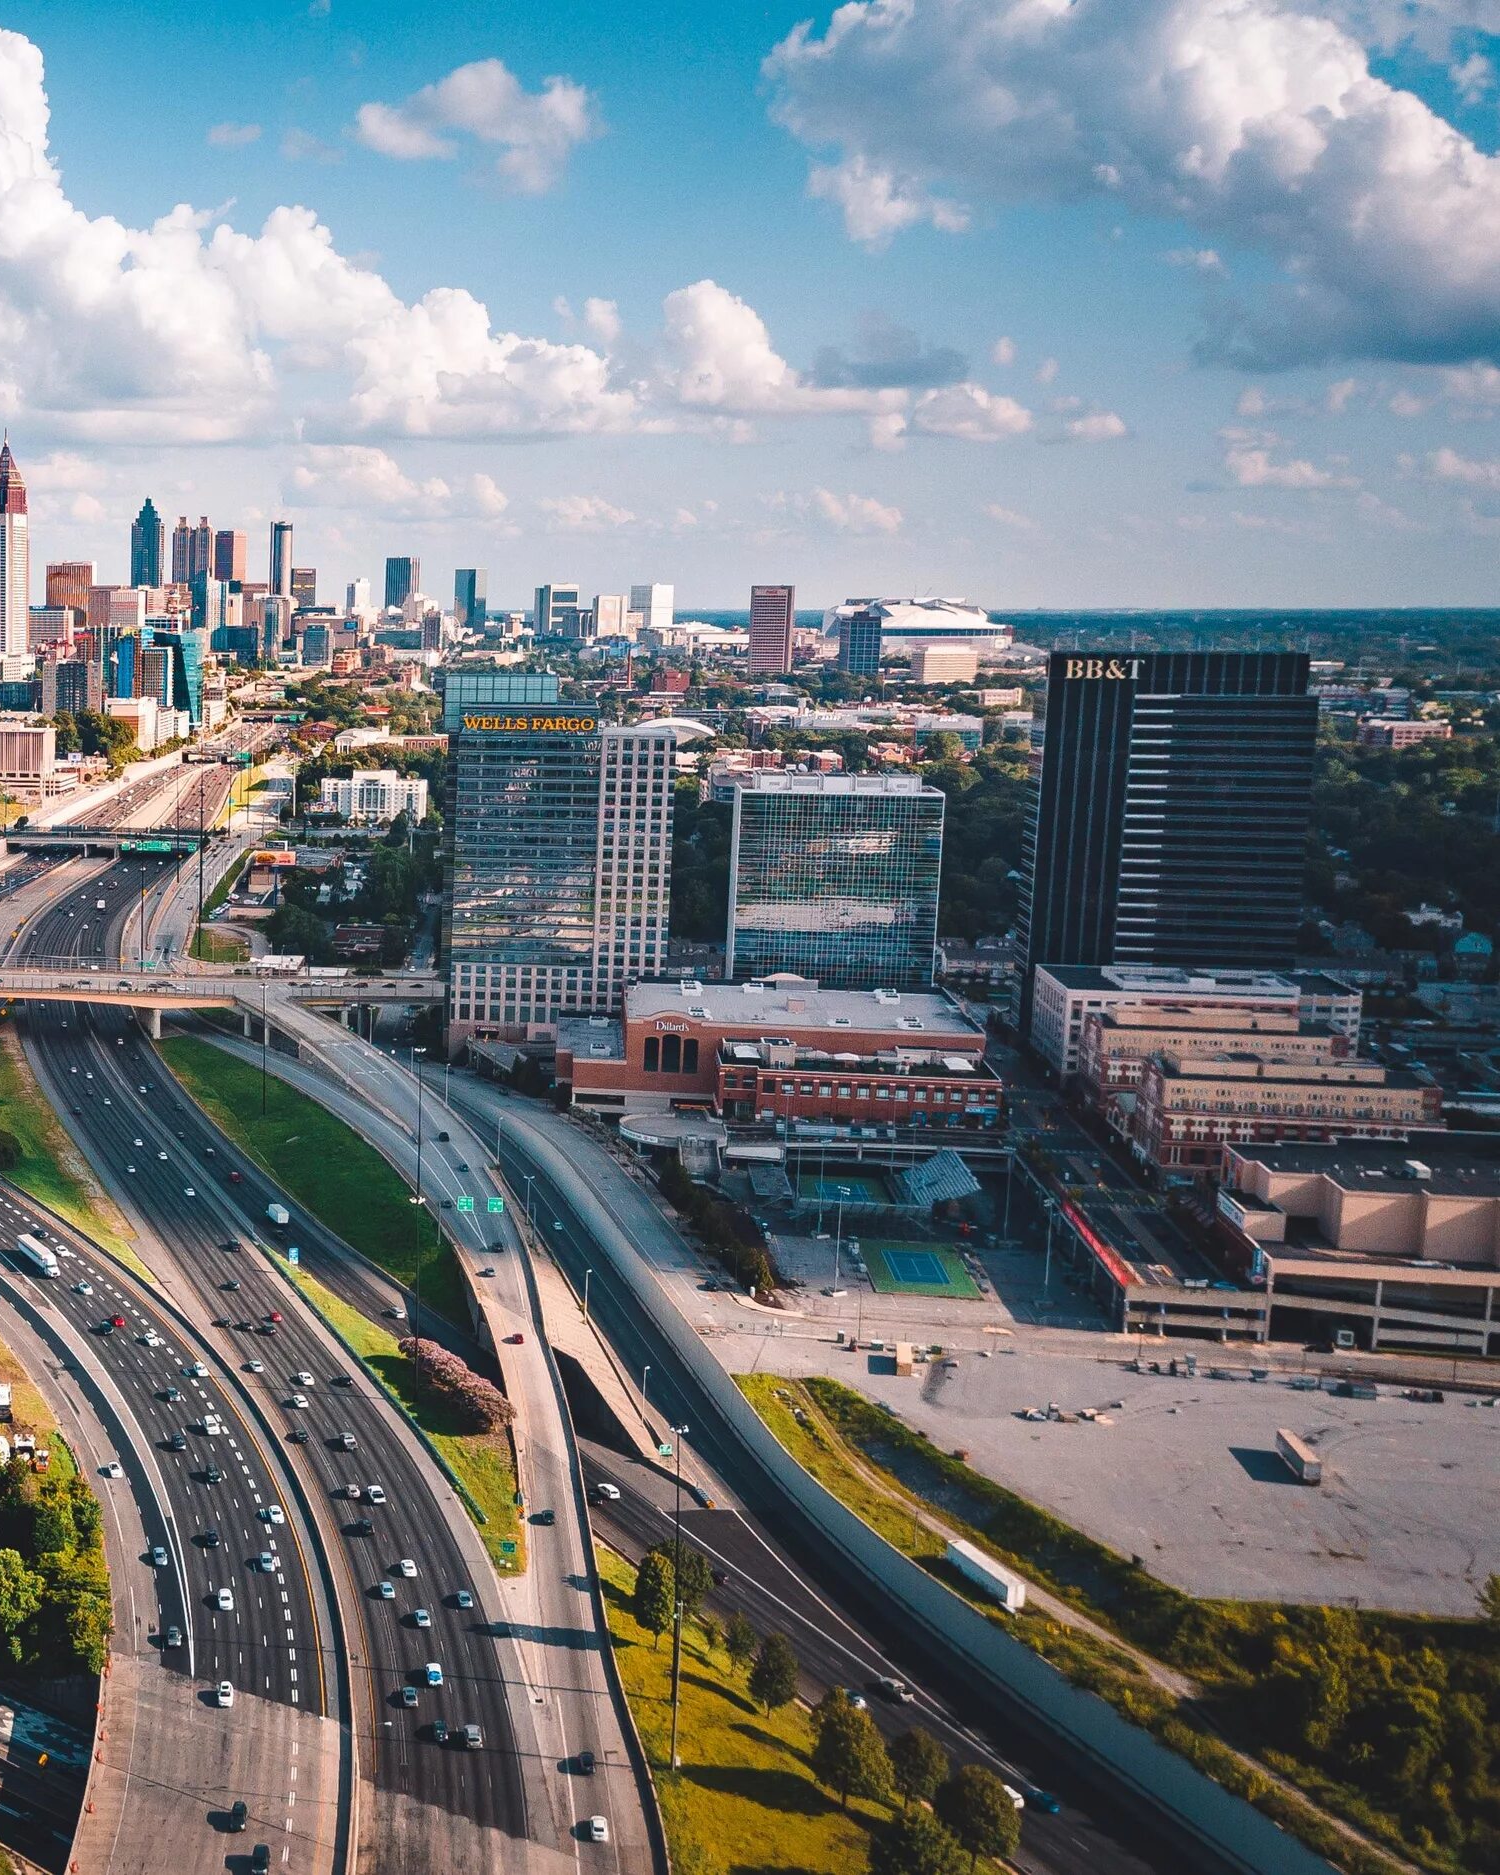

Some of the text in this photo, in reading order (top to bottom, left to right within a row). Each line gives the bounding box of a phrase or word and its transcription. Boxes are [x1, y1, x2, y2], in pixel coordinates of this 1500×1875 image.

[1065, 659, 1145, 679] BB&T
[464, 717, 595, 731] WELLS FARGO
[655, 1021, 690, 1031] Dillard's
